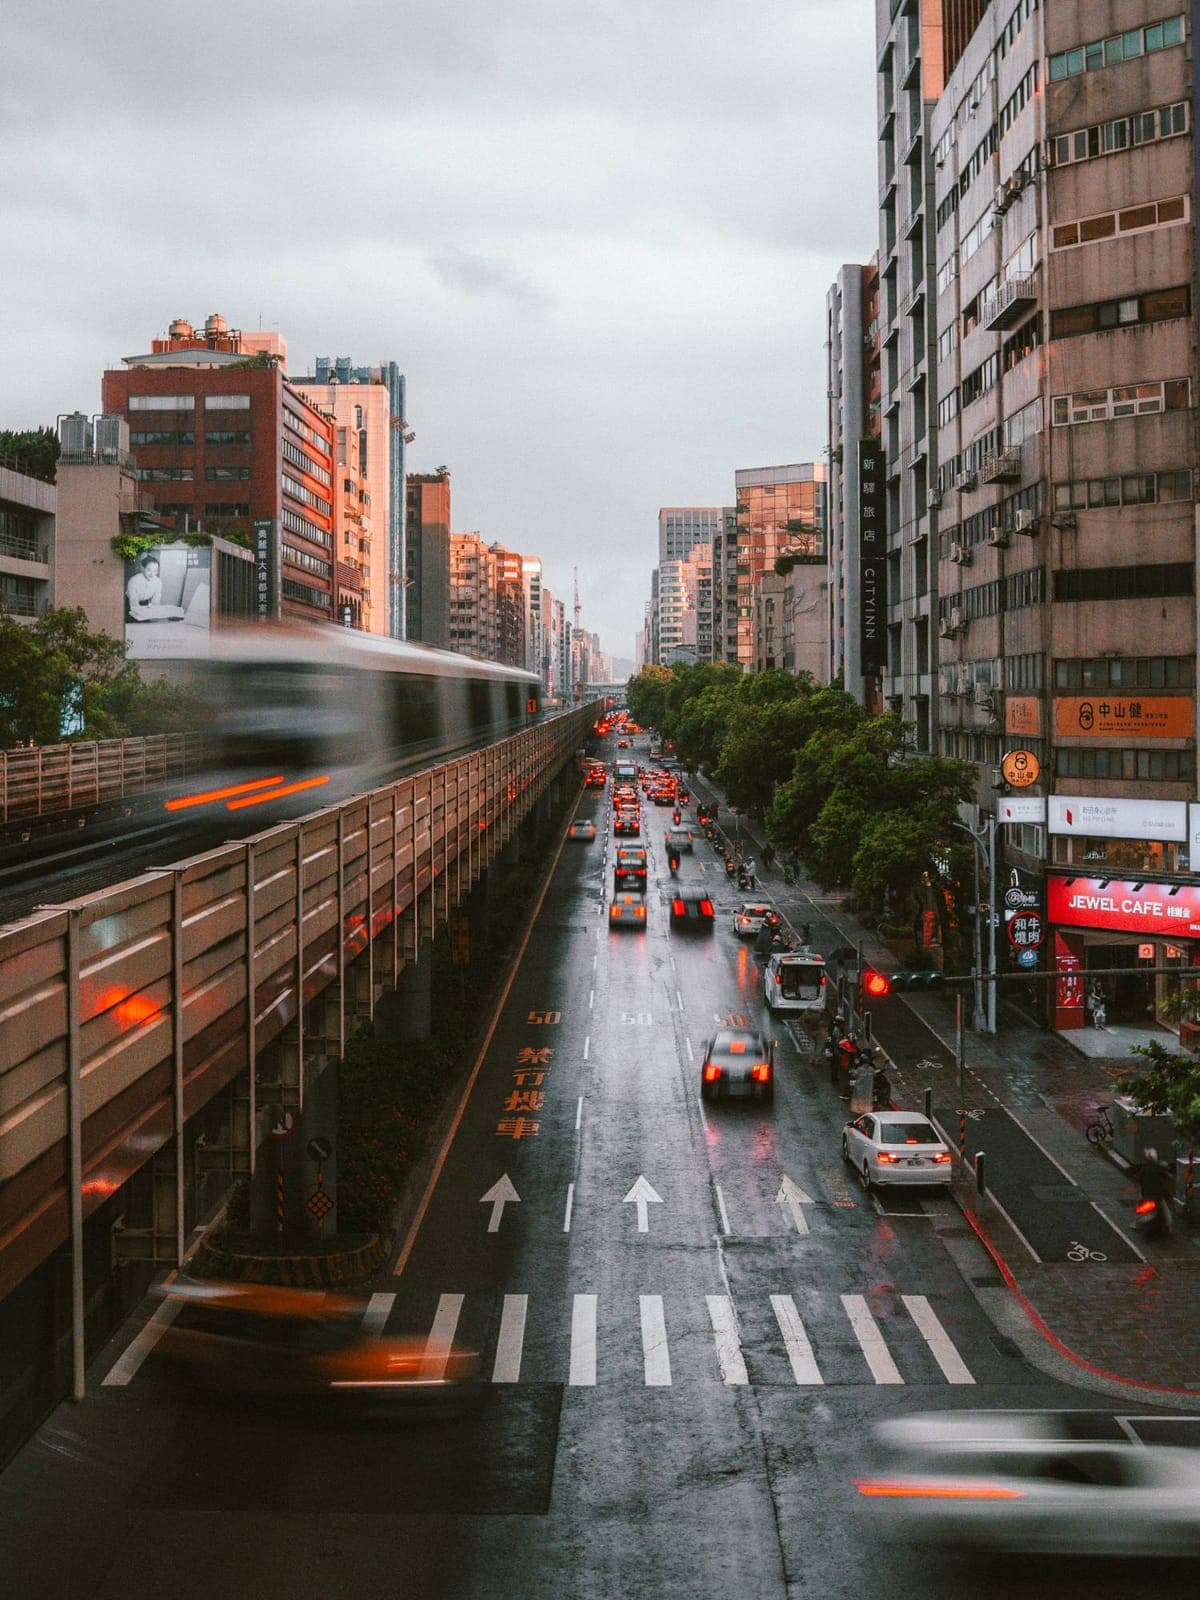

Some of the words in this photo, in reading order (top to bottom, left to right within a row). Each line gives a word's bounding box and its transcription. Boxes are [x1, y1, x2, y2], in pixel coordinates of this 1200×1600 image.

[863, 458, 876, 542] 新驛旅店
[864, 568, 876, 639] CITYINN
[1099, 702, 1142, 718] 中山健
[1068, 895, 1119, 912] JEWEL
[1121, 899, 1163, 916] CAFE
[527, 1010, 561, 1025] 50
[621, 1012, 652, 1025] 50
[495, 1046, 553, 1139] 禁行機車
